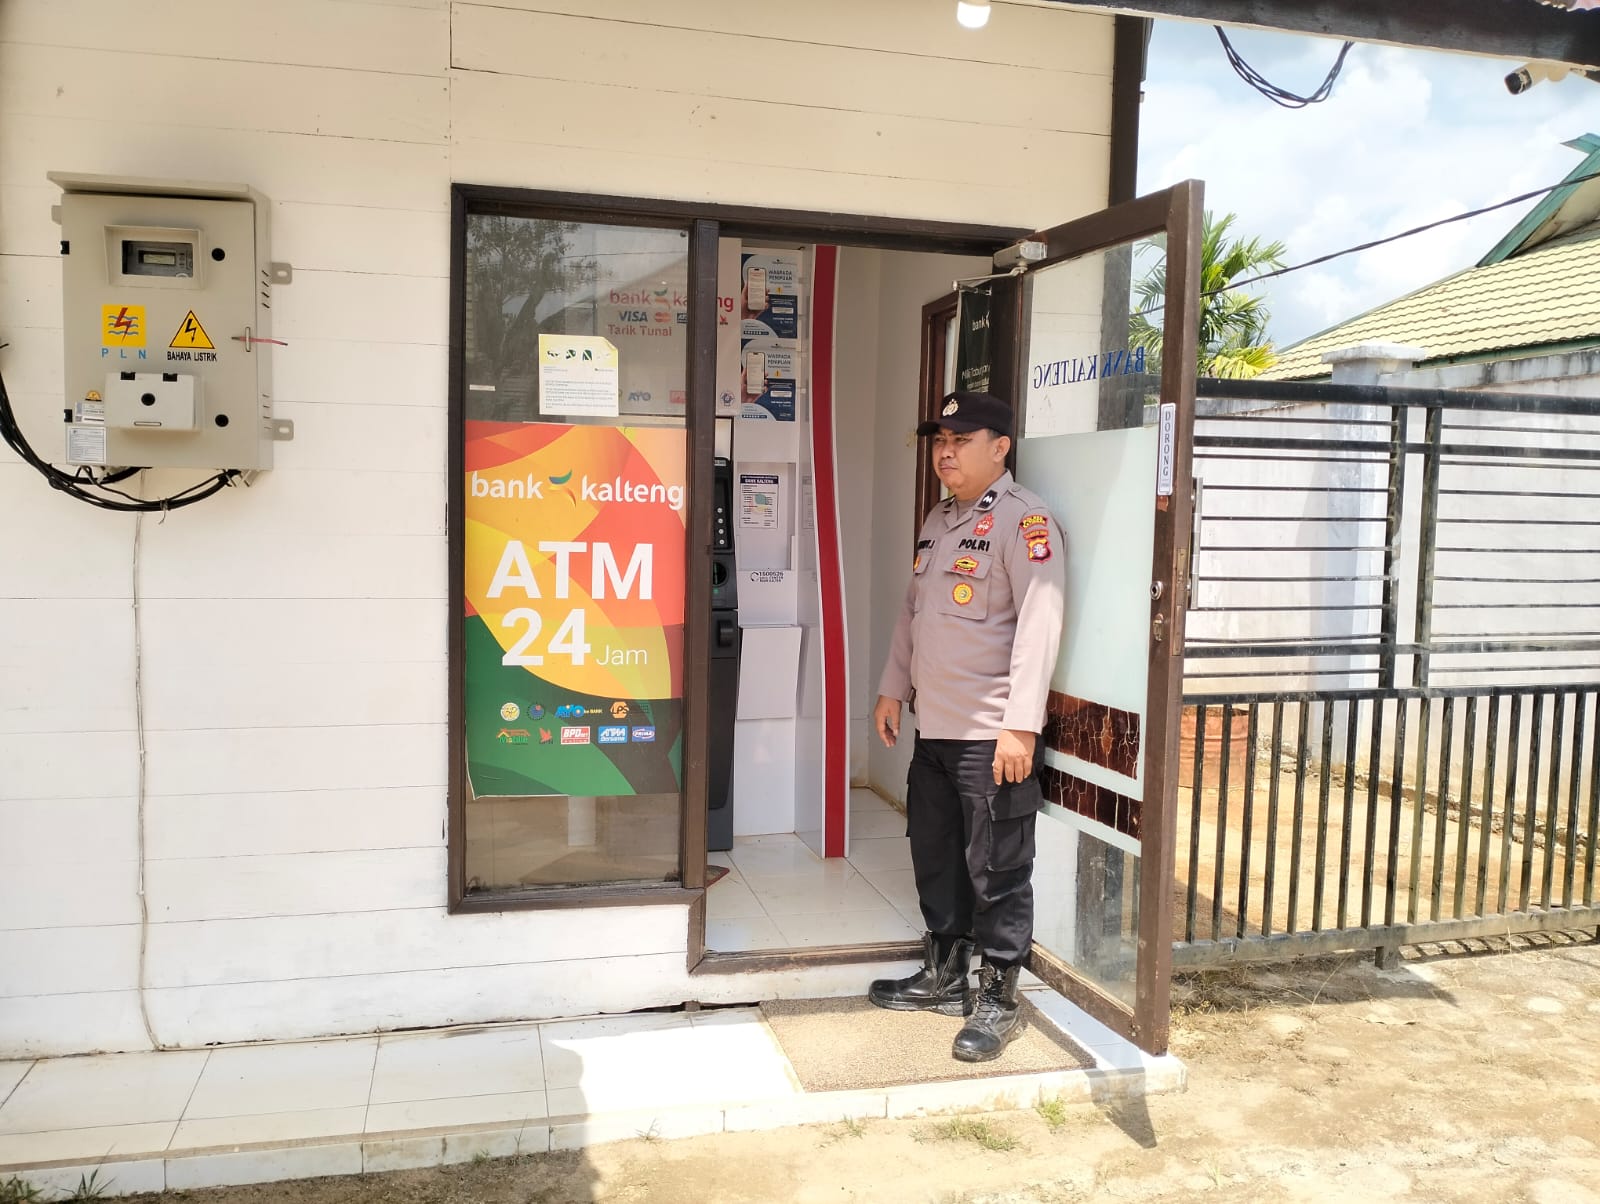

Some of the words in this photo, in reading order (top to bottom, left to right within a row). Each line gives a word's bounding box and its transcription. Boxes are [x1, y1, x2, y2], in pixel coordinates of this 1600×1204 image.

[609, 289, 651, 305] bank
[619, 311, 648, 322] VISA
[607, 325, 636, 336] Tarik
[640, 326, 672, 337] Tunai
[101, 348, 147, 360] PLN
[167, 351, 191, 361] BAHAYA
[194, 352, 217, 362] LISTRIK
[1162, 410, 1171, 477] DORONG
[471, 471, 544, 500] bank
[581, 475, 685, 511] kalteng
[958, 538, 991, 552] POLRI
[486, 540, 653, 600] ATM
[501, 607, 592, 667] 24
[595, 645, 648, 666] Jam
